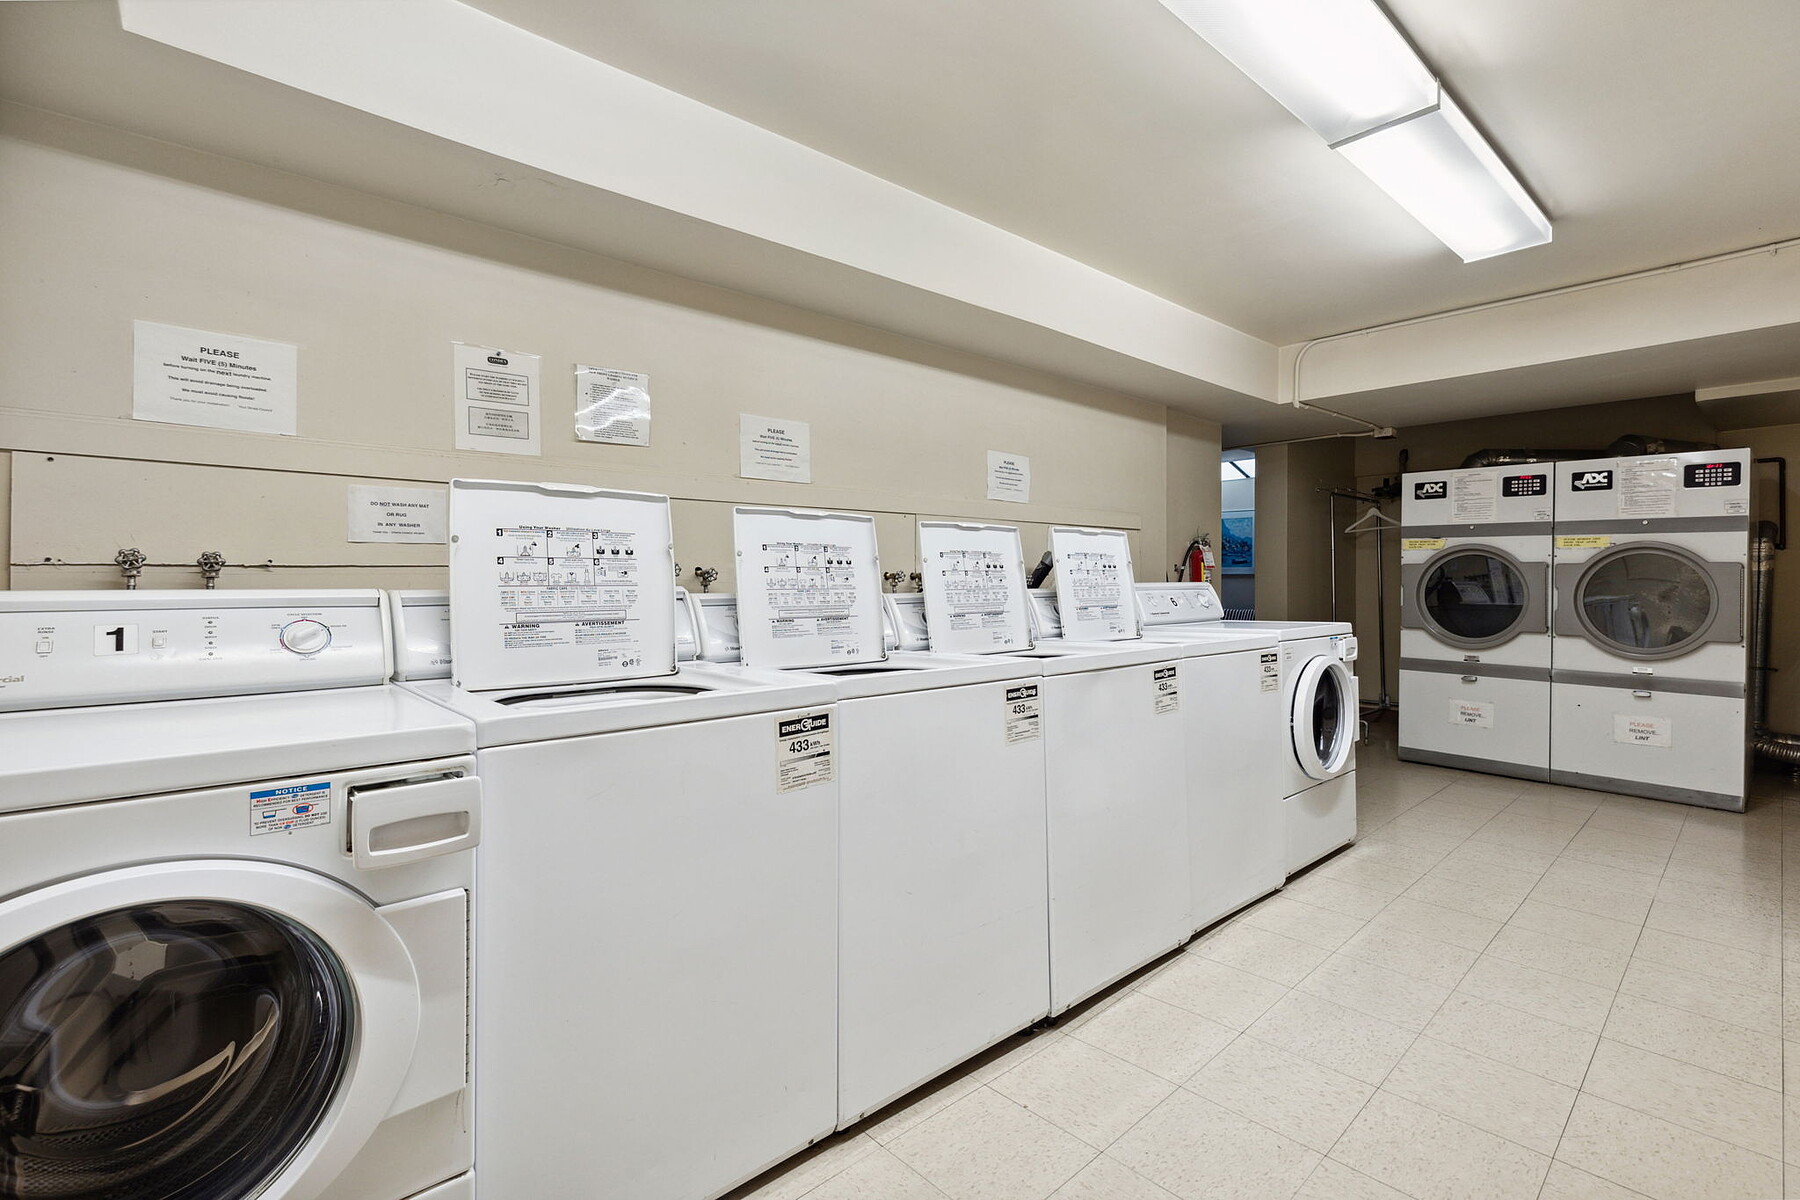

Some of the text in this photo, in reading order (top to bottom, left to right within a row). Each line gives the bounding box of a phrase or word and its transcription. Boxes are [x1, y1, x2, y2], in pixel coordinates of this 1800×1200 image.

[200, 347, 240, 359] PLEASE
[230, 362, 257, 371] Minutes
[1582, 472, 1608, 484] ADC
[1423, 483, 1443, 493] ADC
[1170, 597, 1178, 606] 6
[106, 627, 124, 652] 1
[1158, 683, 1168, 691] 433
[1013, 704, 1025, 714] 433
[782, 718, 826, 733] ENERGUIDE
[789, 739, 810, 753] 433
[275, 786, 308, 795] NOTICE
